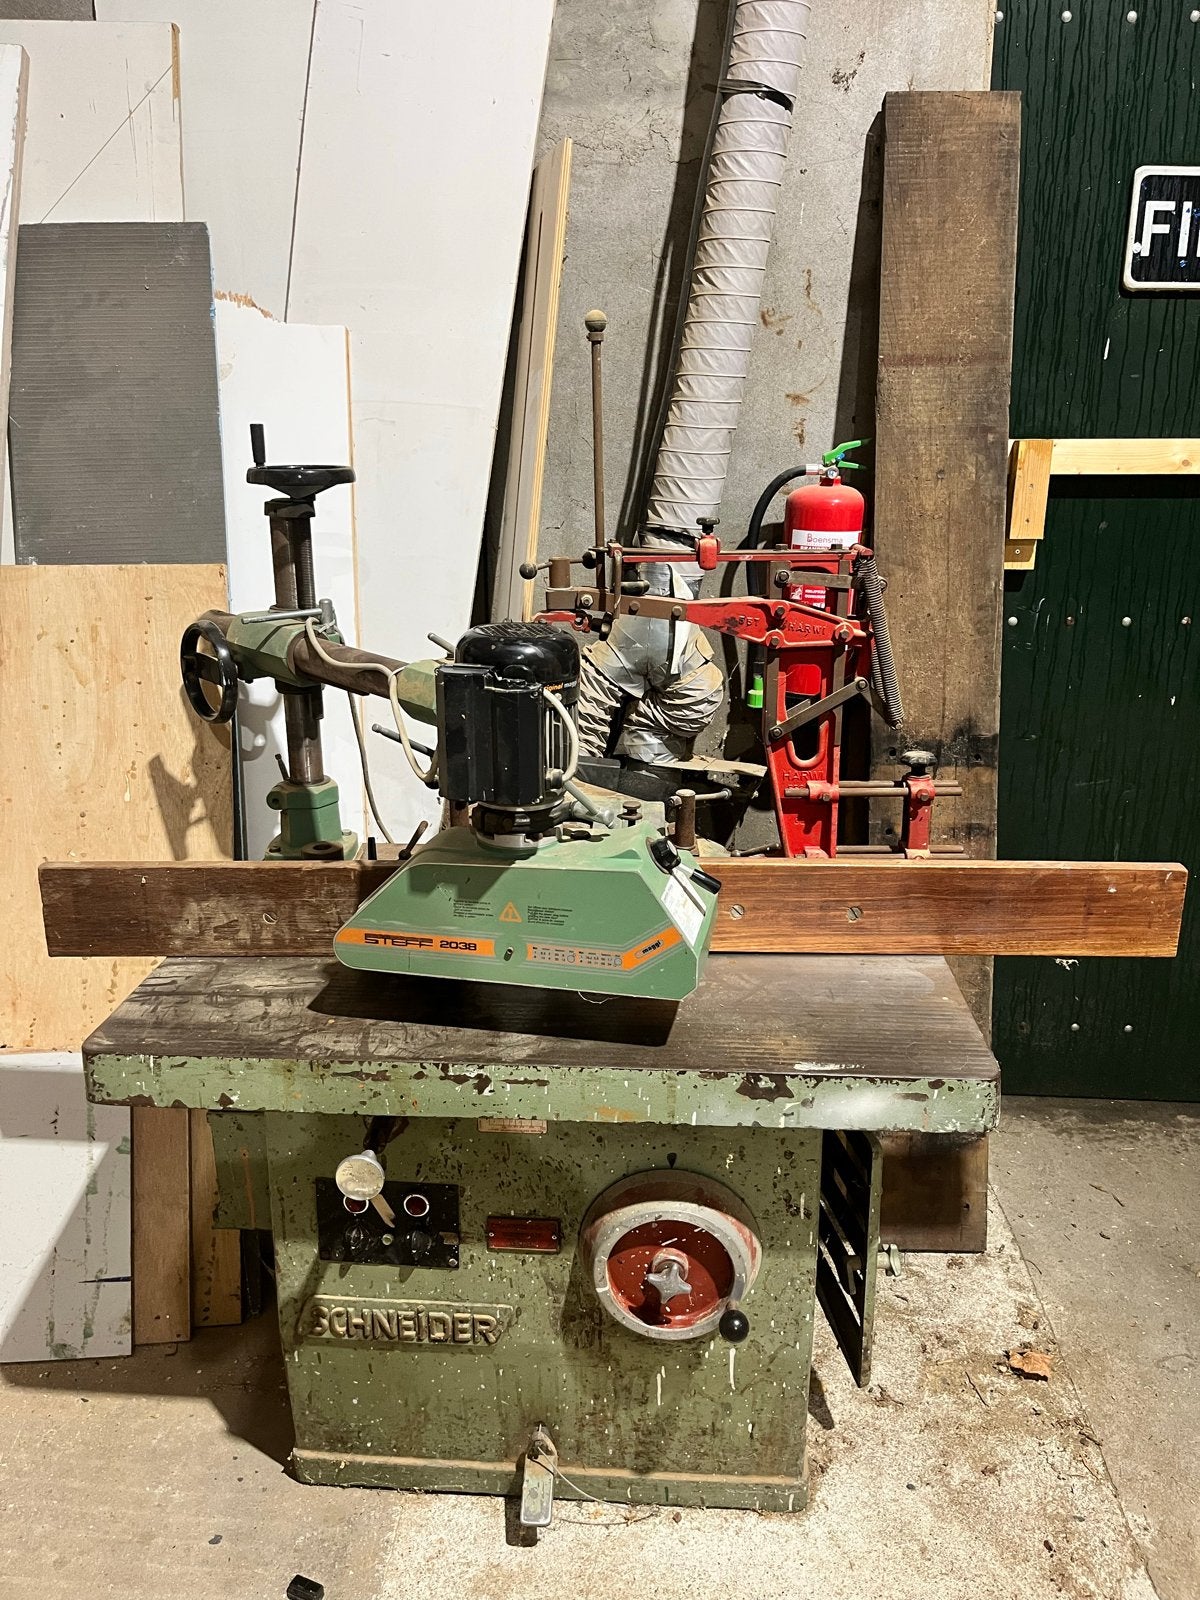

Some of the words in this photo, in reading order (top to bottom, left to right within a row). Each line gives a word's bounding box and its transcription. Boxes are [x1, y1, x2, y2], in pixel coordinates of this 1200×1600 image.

[1140, 201, 1200, 258] FI
[364, 933, 433, 948] STEFF
[440, 940, 477, 951] 2038
[641, 940, 661, 955] maggi
